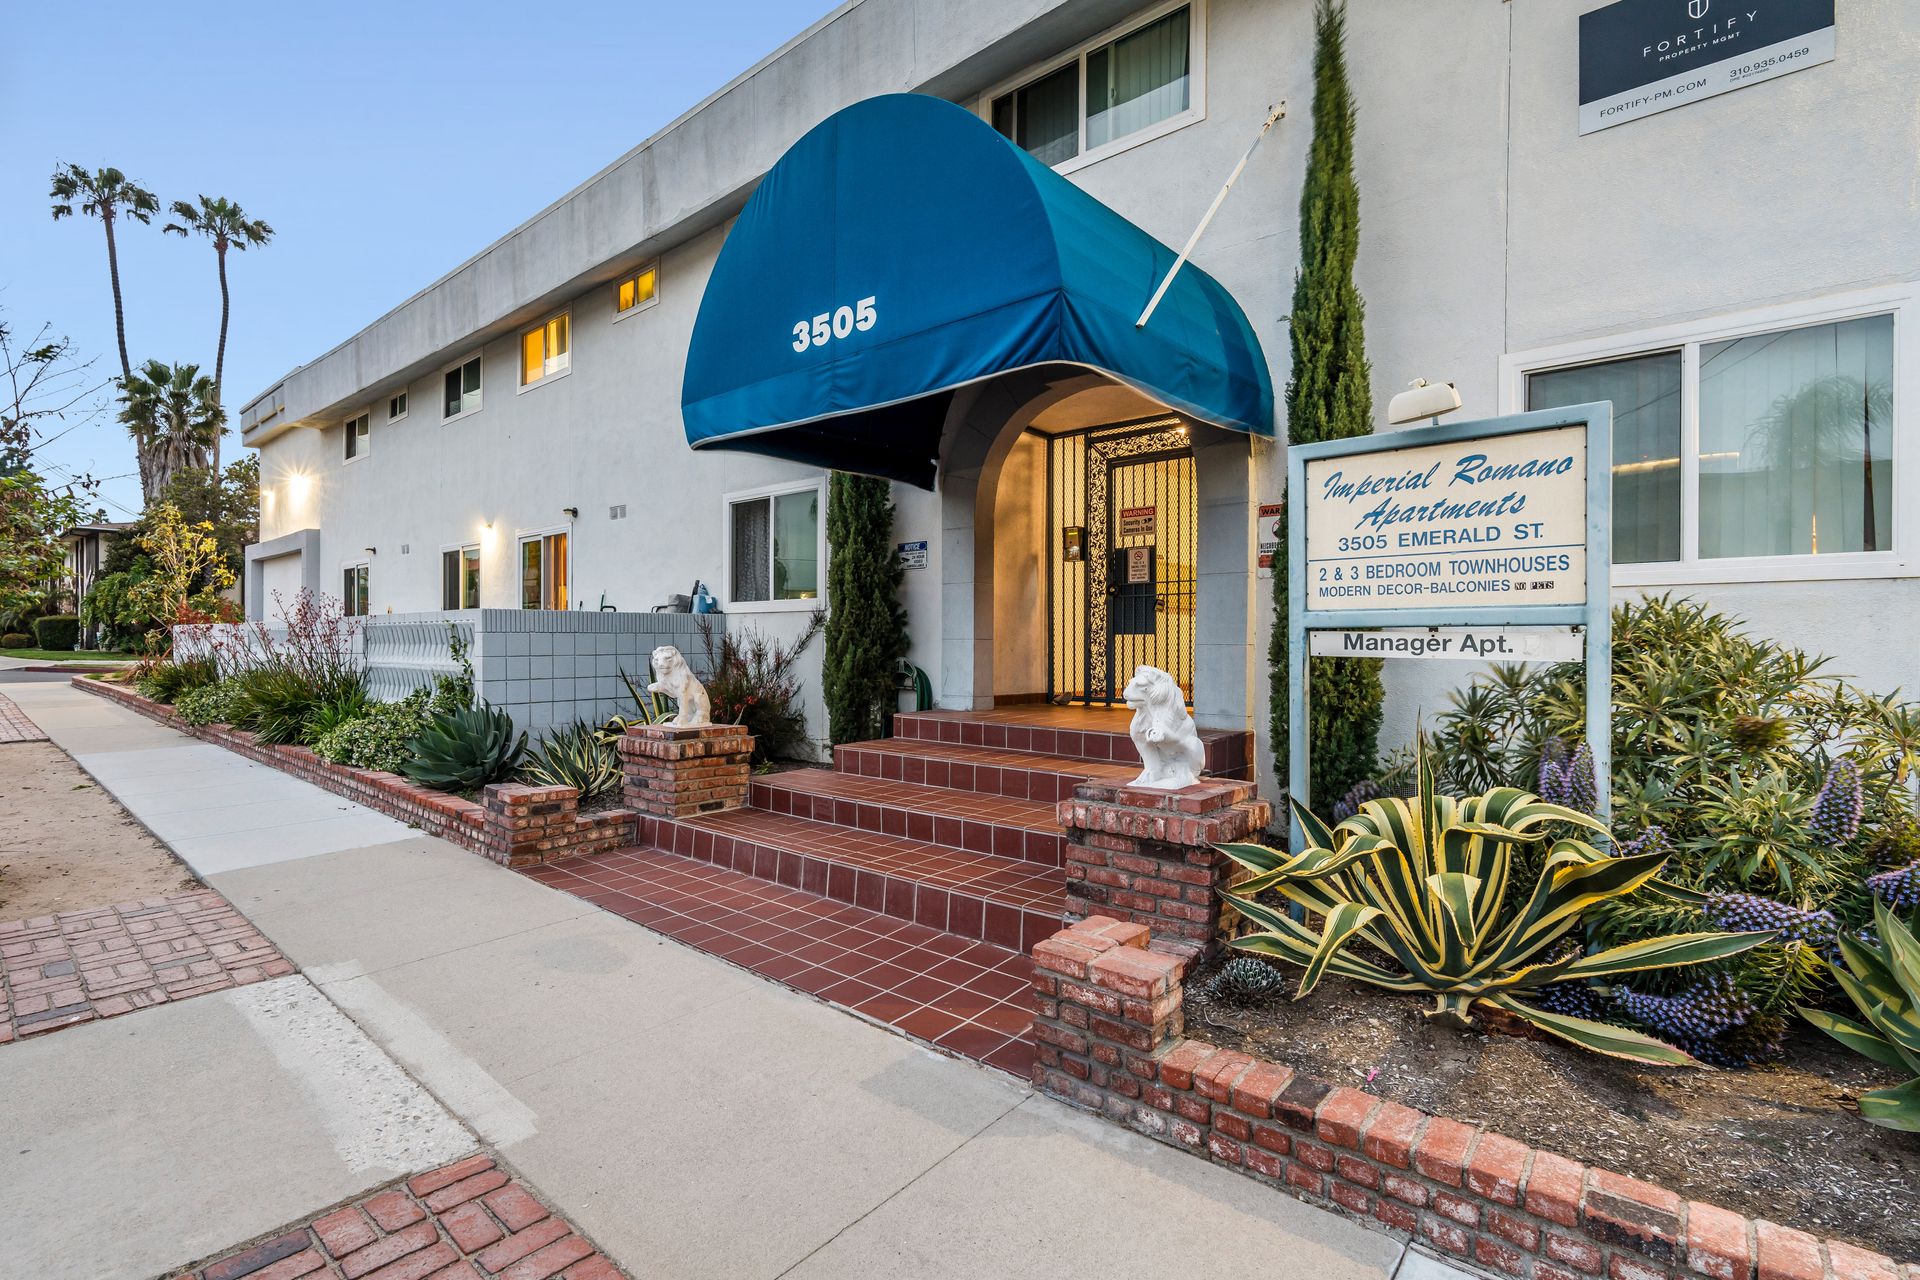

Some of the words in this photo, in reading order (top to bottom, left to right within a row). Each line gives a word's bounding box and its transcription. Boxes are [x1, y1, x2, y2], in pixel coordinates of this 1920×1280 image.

[1643, 10, 1757, 57] FORTIFY
[1659, 42, 1708, 62] PROPERTY
[1712, 31, 1741, 45] MGMT
[1729, 47, 1810, 78] 310.935.0459
[1600, 78, 1707, 118] FORTIFY-PM.COM
[792, 295, 878, 353] 3505
[1323, 461, 1441, 504] Imperial
[1448, 454, 1574, 487] Romano
[1122, 508, 1154, 517] WARNING
[1123, 519, 1140, 527] Security
[1354, 491, 1527, 533] Apartments
[1338, 534, 1388, 552] 3505
[1398, 526, 1501, 548] EMERALD
[1513, 522, 1545, 541] ST.
[1319, 567, 1328, 582] 2
[1334, 566, 1344, 581] &
[1350, 565, 1360, 580] 3
[1366, 561, 1442, 580] BEDROOM
[1449, 554, 1571, 576] TOWNHOUSES
[1319, 584, 1372, 598] MODERN
[1377, 578, 1511, 596] DECOR-BALCONIES
[1343, 632, 1453, 656] Manager
[1459, 633, 1514, 657] Apt.
